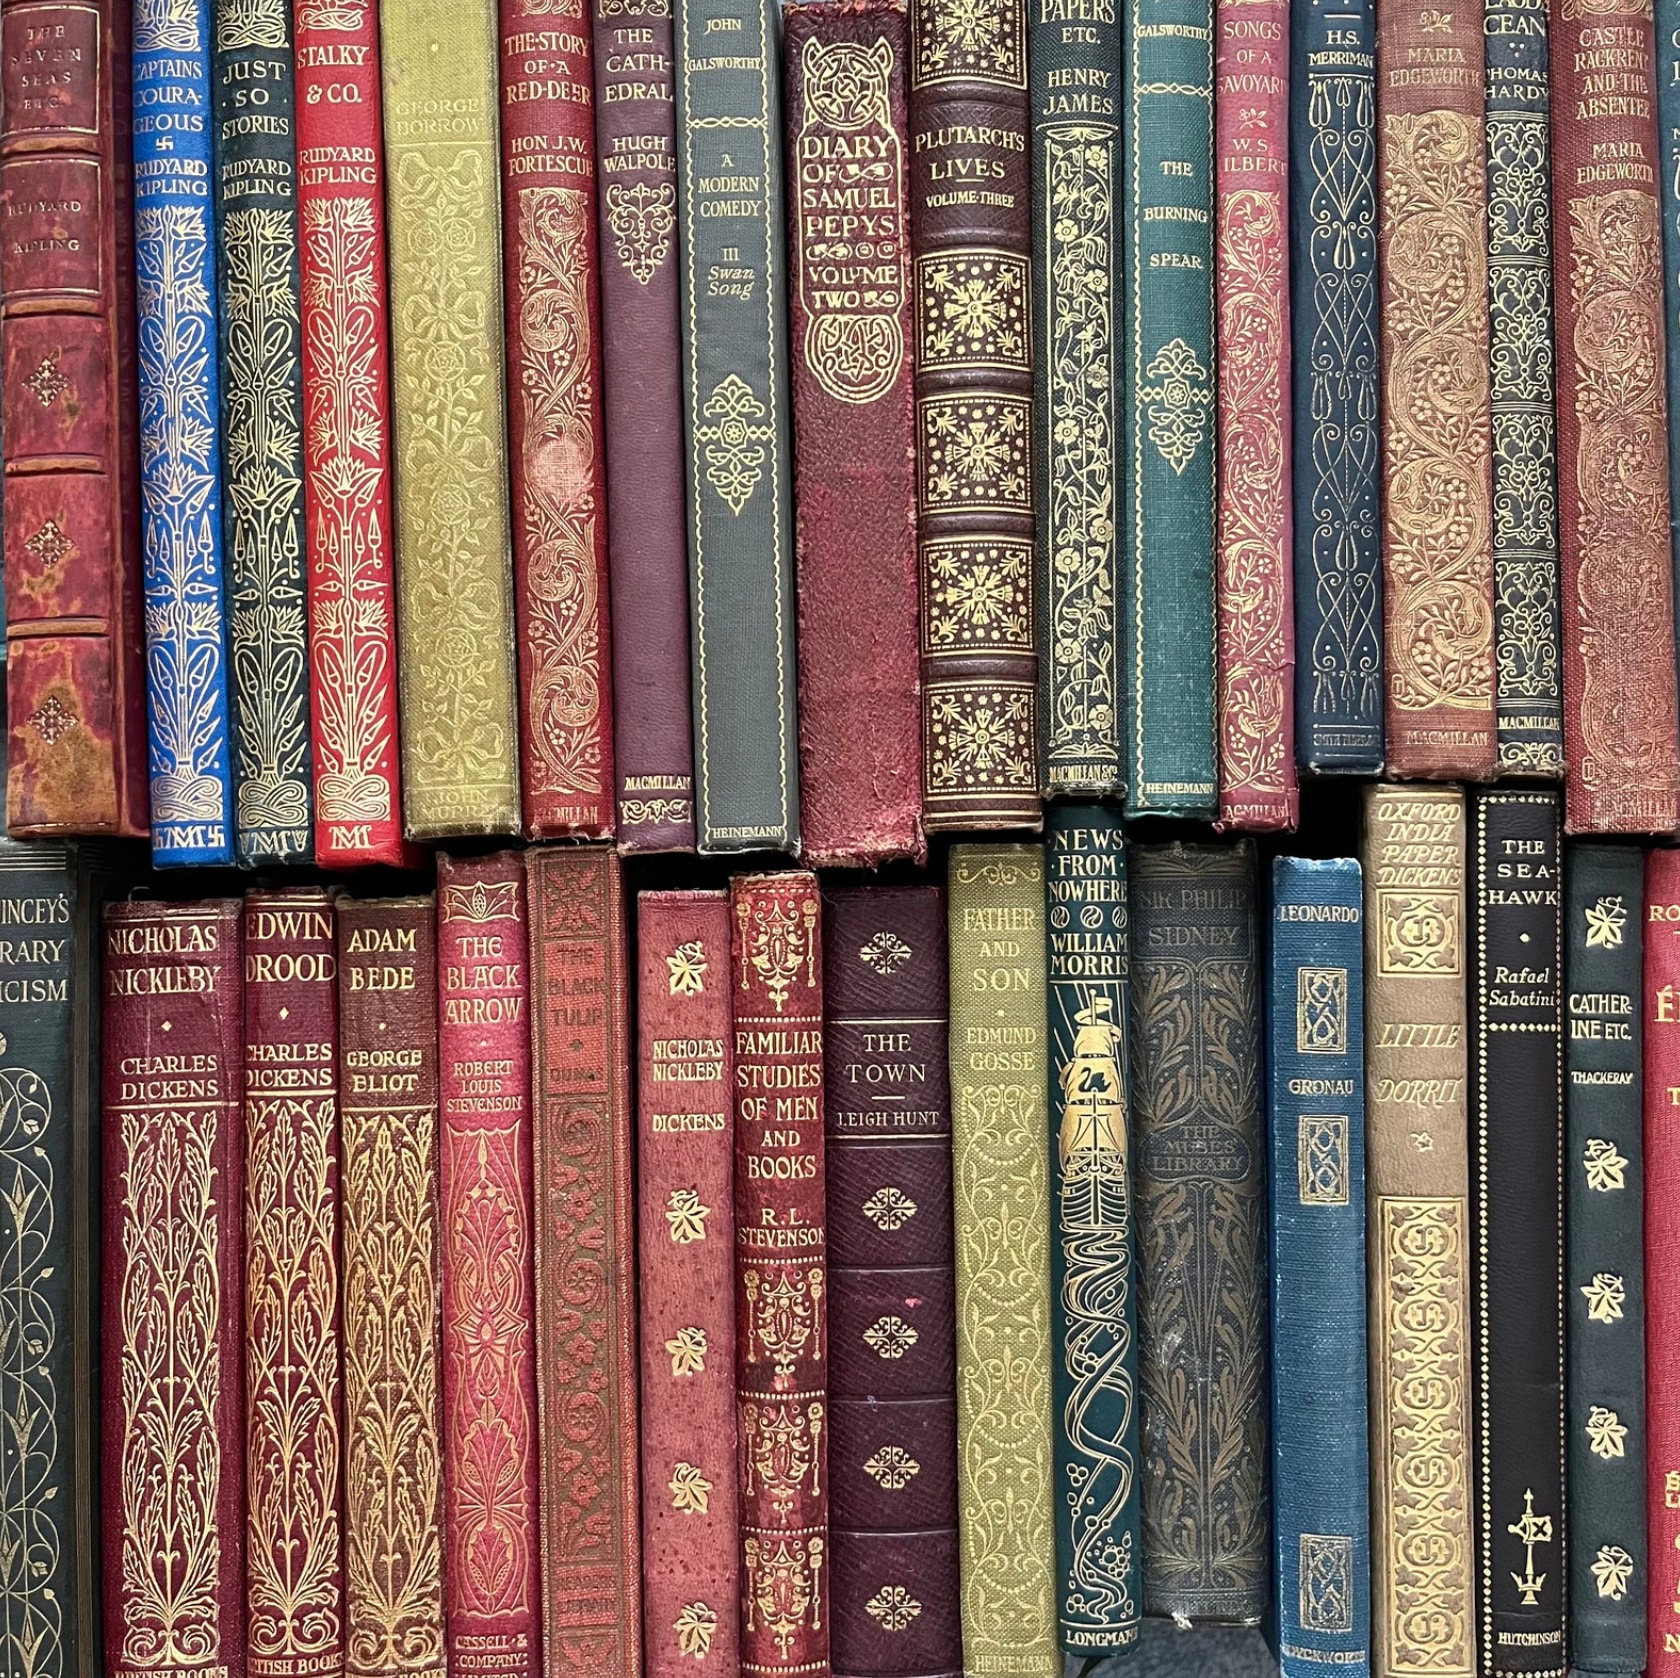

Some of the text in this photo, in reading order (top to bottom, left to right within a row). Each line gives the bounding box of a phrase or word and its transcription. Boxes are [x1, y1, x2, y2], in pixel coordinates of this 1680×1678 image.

[1041, 0, 1115, 24] PAPERS
[705, 19, 741, 34] JOHN
[1061, 26, 1100, 44] ETC.
[1138, 24, 1209, 41] GALSWORTHY
[1223, 21, 1282, 41] SONGS
[613, 29, 653, 44] THE
[1579, 27, 1645, 48] CASTLE
[298, 45, 369, 68] STALKY
[606, 54, 670, 73] CATH-
[689, 56, 762, 71] GALSWORTHY
[1236, 50, 1273, 65] OF A
[1307, 51, 1375, 68] MERRIMAN
[1408, 48, 1467, 63] MARIA
[222, 60, 287, 85] JUST
[1048, 68, 1112, 89] HENRY
[1390, 67, 1480, 88] EDGEWORTH
[235, 88, 270, 107] SO
[327, 83, 363, 103] CO.
[604, 83, 673, 103] EDRAL
[395, 99, 480, 116] GEORGE
[1043, 93, 1114, 116] JAMES
[133, 113, 203, 134] GEOUS
[222, 114, 289, 140] STORIES
[396, 118, 483, 136] BORROW
[511, 138, 546, 154] HON
[613, 137, 668, 153] HUGH
[803, 136, 892, 159] DIARY
[915, 126, 1025, 153] PLUTARCH'S
[300, 147, 376, 165] RUDYARD
[1592, 142, 1646, 159] MARIA
[135, 158, 208, 178] RUDYARD
[222, 158, 292, 181] RUDYARD
[509, 155, 593, 176] FORTESCUE
[604, 155, 676, 173] WALPOLE
[721, 154, 734, 168] A
[930, 160, 1005, 181] LIVES
[1160, 161, 1193, 176] THE
[1222, 156, 1287, 176] ILBERT
[301, 166, 376, 186] KIPLING
[803, 163, 838, 183] OF
[136, 179, 208, 197] KIPLING
[223, 178, 292, 200] KIPLING
[698, 177, 759, 195] MODERN
[803, 188, 895, 209] SAMUEL
[700, 200, 762, 218] COMEDY
[1143, 208, 1209, 223] BURNING
[806, 215, 894, 237] PEPYS
[721, 248, 740, 261] III
[1150, 254, 1202, 270] SPEAR
[708, 266, 755, 280] Swan
[809, 266, 898, 285] VOLUME
[708, 282, 755, 299] Song
[811, 290, 860, 309] TWO
[1498, 715, 1560, 731] MACMILLAN
[1405, 731, 1488, 747] MACMILLAN
[624, 775, 691, 791] MACMILLAN
[1145, 783, 1214, 795] HEINEMANN
[1378, 803, 1461, 822] OXFORD
[712, 825, 781, 840] HEINEMANN
[1054, 829, 1124, 850] NEWS
[1383, 823, 1455, 842] INDIA
[1381, 845, 1460, 865] PAPER
[1502, 840, 1545, 855] THE
[1058, 855, 1117, 877] FROM
[1376, 867, 1461, 887] DICKENS
[1050, 880, 1127, 903] NOWHERE
[1488, 890, 1558, 905] HAWK
[963, 908, 1036, 932] FATHER
[1279, 905, 1359, 923] LEONARDO
[247, 912, 334, 940] EDWIN
[108, 925, 217, 955] NICHOLAS
[347, 929, 418, 953] ADAM
[1051, 933, 1128, 954] WILLIAM
[1149, 926, 1240, 947] SIDNEY
[456, 936, 503, 959] THE
[979, 941, 1020, 957] AND
[1051, 954, 1128, 976] MORRIS
[110, 965, 222, 996] NICKLEBY
[349, 967, 416, 991] BEDE
[447, 964, 521, 990] BLACK
[973, 967, 1030, 992] SON
[1494, 967, 1549, 985] Rafael
[1489, 989, 1555, 1007] Sabatini
[444, 997, 521, 1025] ARROW
[966, 1027, 1037, 1045] EDMUND
[1375, 1024, 1461, 1048] LITTLE
[1571, 1020, 1601, 1040] INE
[653, 1039, 724, 1060] NICHOLAS
[736, 1031, 822, 1055] FAMILIAR
[863, 1034, 912, 1052] THE
[121, 1055, 218, 1076] CHARLES
[347, 1050, 422, 1067] GEORGE
[970, 1051, 1035, 1071] GOSSE
[454, 1060, 514, 1077] ROBERT
[653, 1061, 723, 1082] NICKLEBY
[738, 1064, 821, 1088] STUDIES
[846, 1063, 926, 1083] TOWN
[1571, 1071, 1633, 1085] THACKERAY
[121, 1079, 219, 1101] DICKENS
[353, 1074, 419, 1092] ELIOT
[461, 1079, 501, 1094] LOUIS
[1289, 1078, 1355, 1096] GRONAU
[1376, 1077, 1463, 1110] DORRIT
[447, 1096, 522, 1113] STEVENSON
[741, 1097, 818, 1121] OF MEN
[652, 1114, 725, 1132] DICKENS
[837, 1111, 939, 1127] LEIGH HUNT
[761, 1130, 801, 1147] AND
[1181, 1125, 1221, 1139] THE
[748, 1155, 816, 1179] BOOKS
[1150, 1155, 1246, 1171] LIBRARY
[738, 1227, 825, 1248] STEVENSON
[455, 1635, 508, 1650] CASSELL
[1497, 1630, 1561, 1646] HUTCHINSON
[974, 1655, 1053, 1673] HEINEMANN
